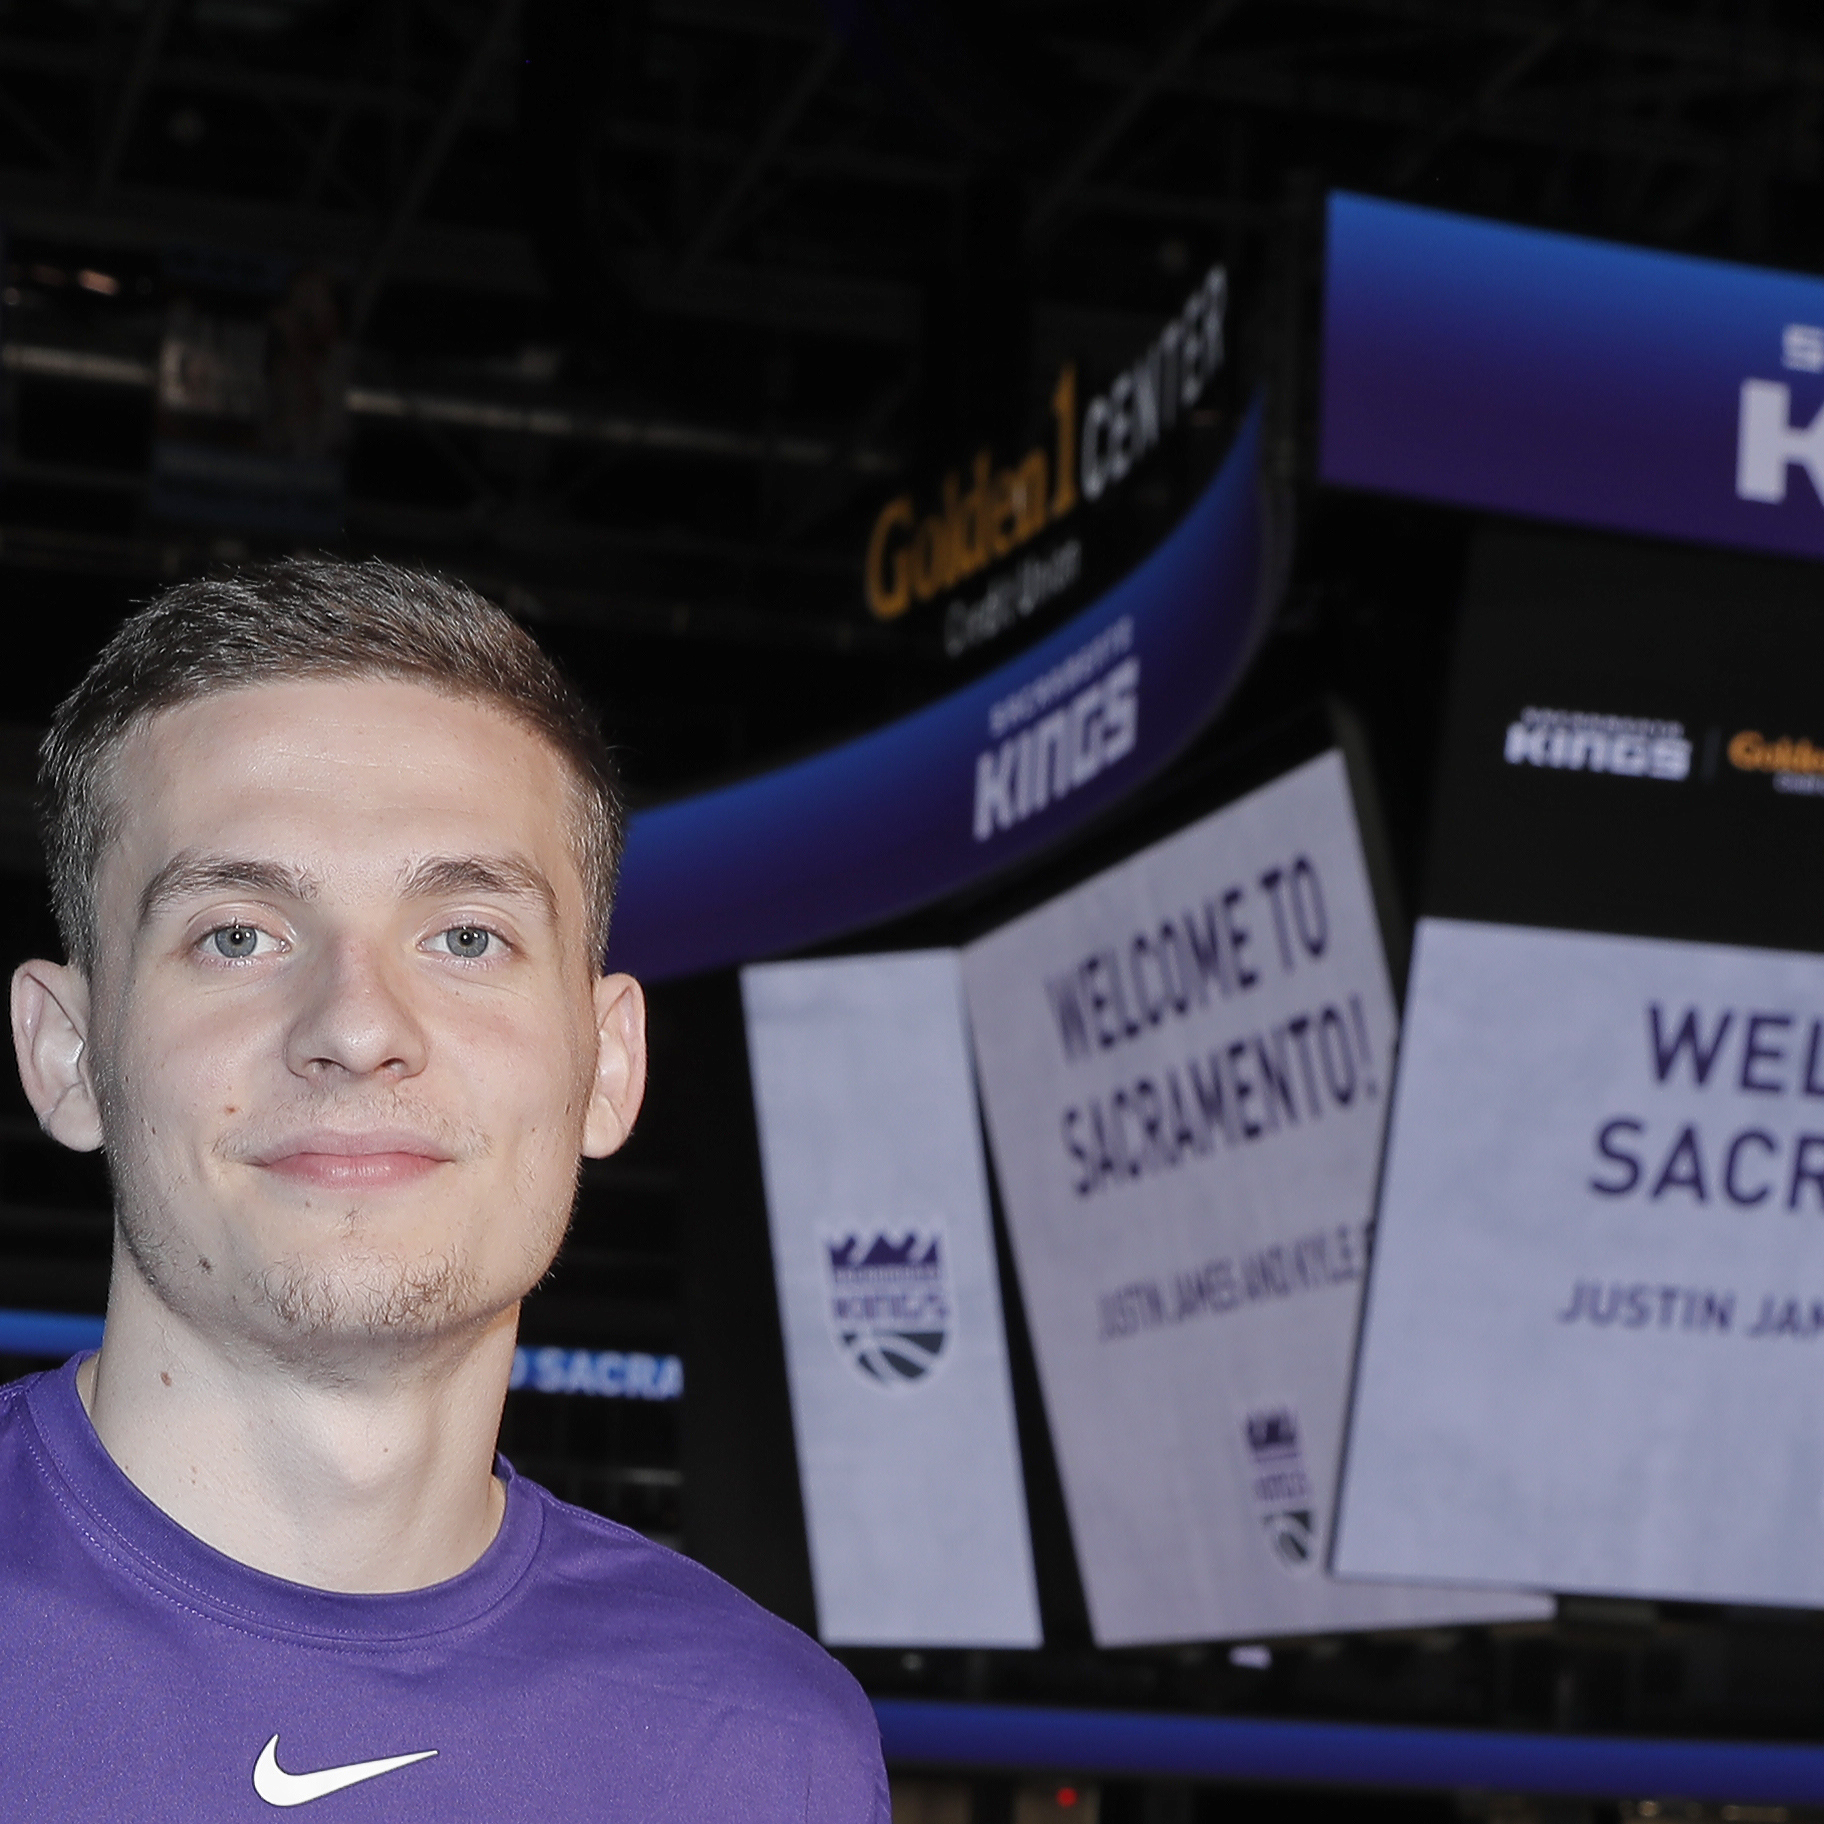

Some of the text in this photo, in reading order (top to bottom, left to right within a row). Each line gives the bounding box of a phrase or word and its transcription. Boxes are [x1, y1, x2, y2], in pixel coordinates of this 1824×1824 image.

[1081, 264, 1227, 502] CENTER
[973, 656, 1141, 843] KINGS
[1503, 720, 1695, 782] KINGS
[1043, 854, 1330, 1067] WELCOME TO
[1060, 994, 1381, 1198] SACRAMENTO!
[1556, 1278, 1736, 1337] JUSTIN
